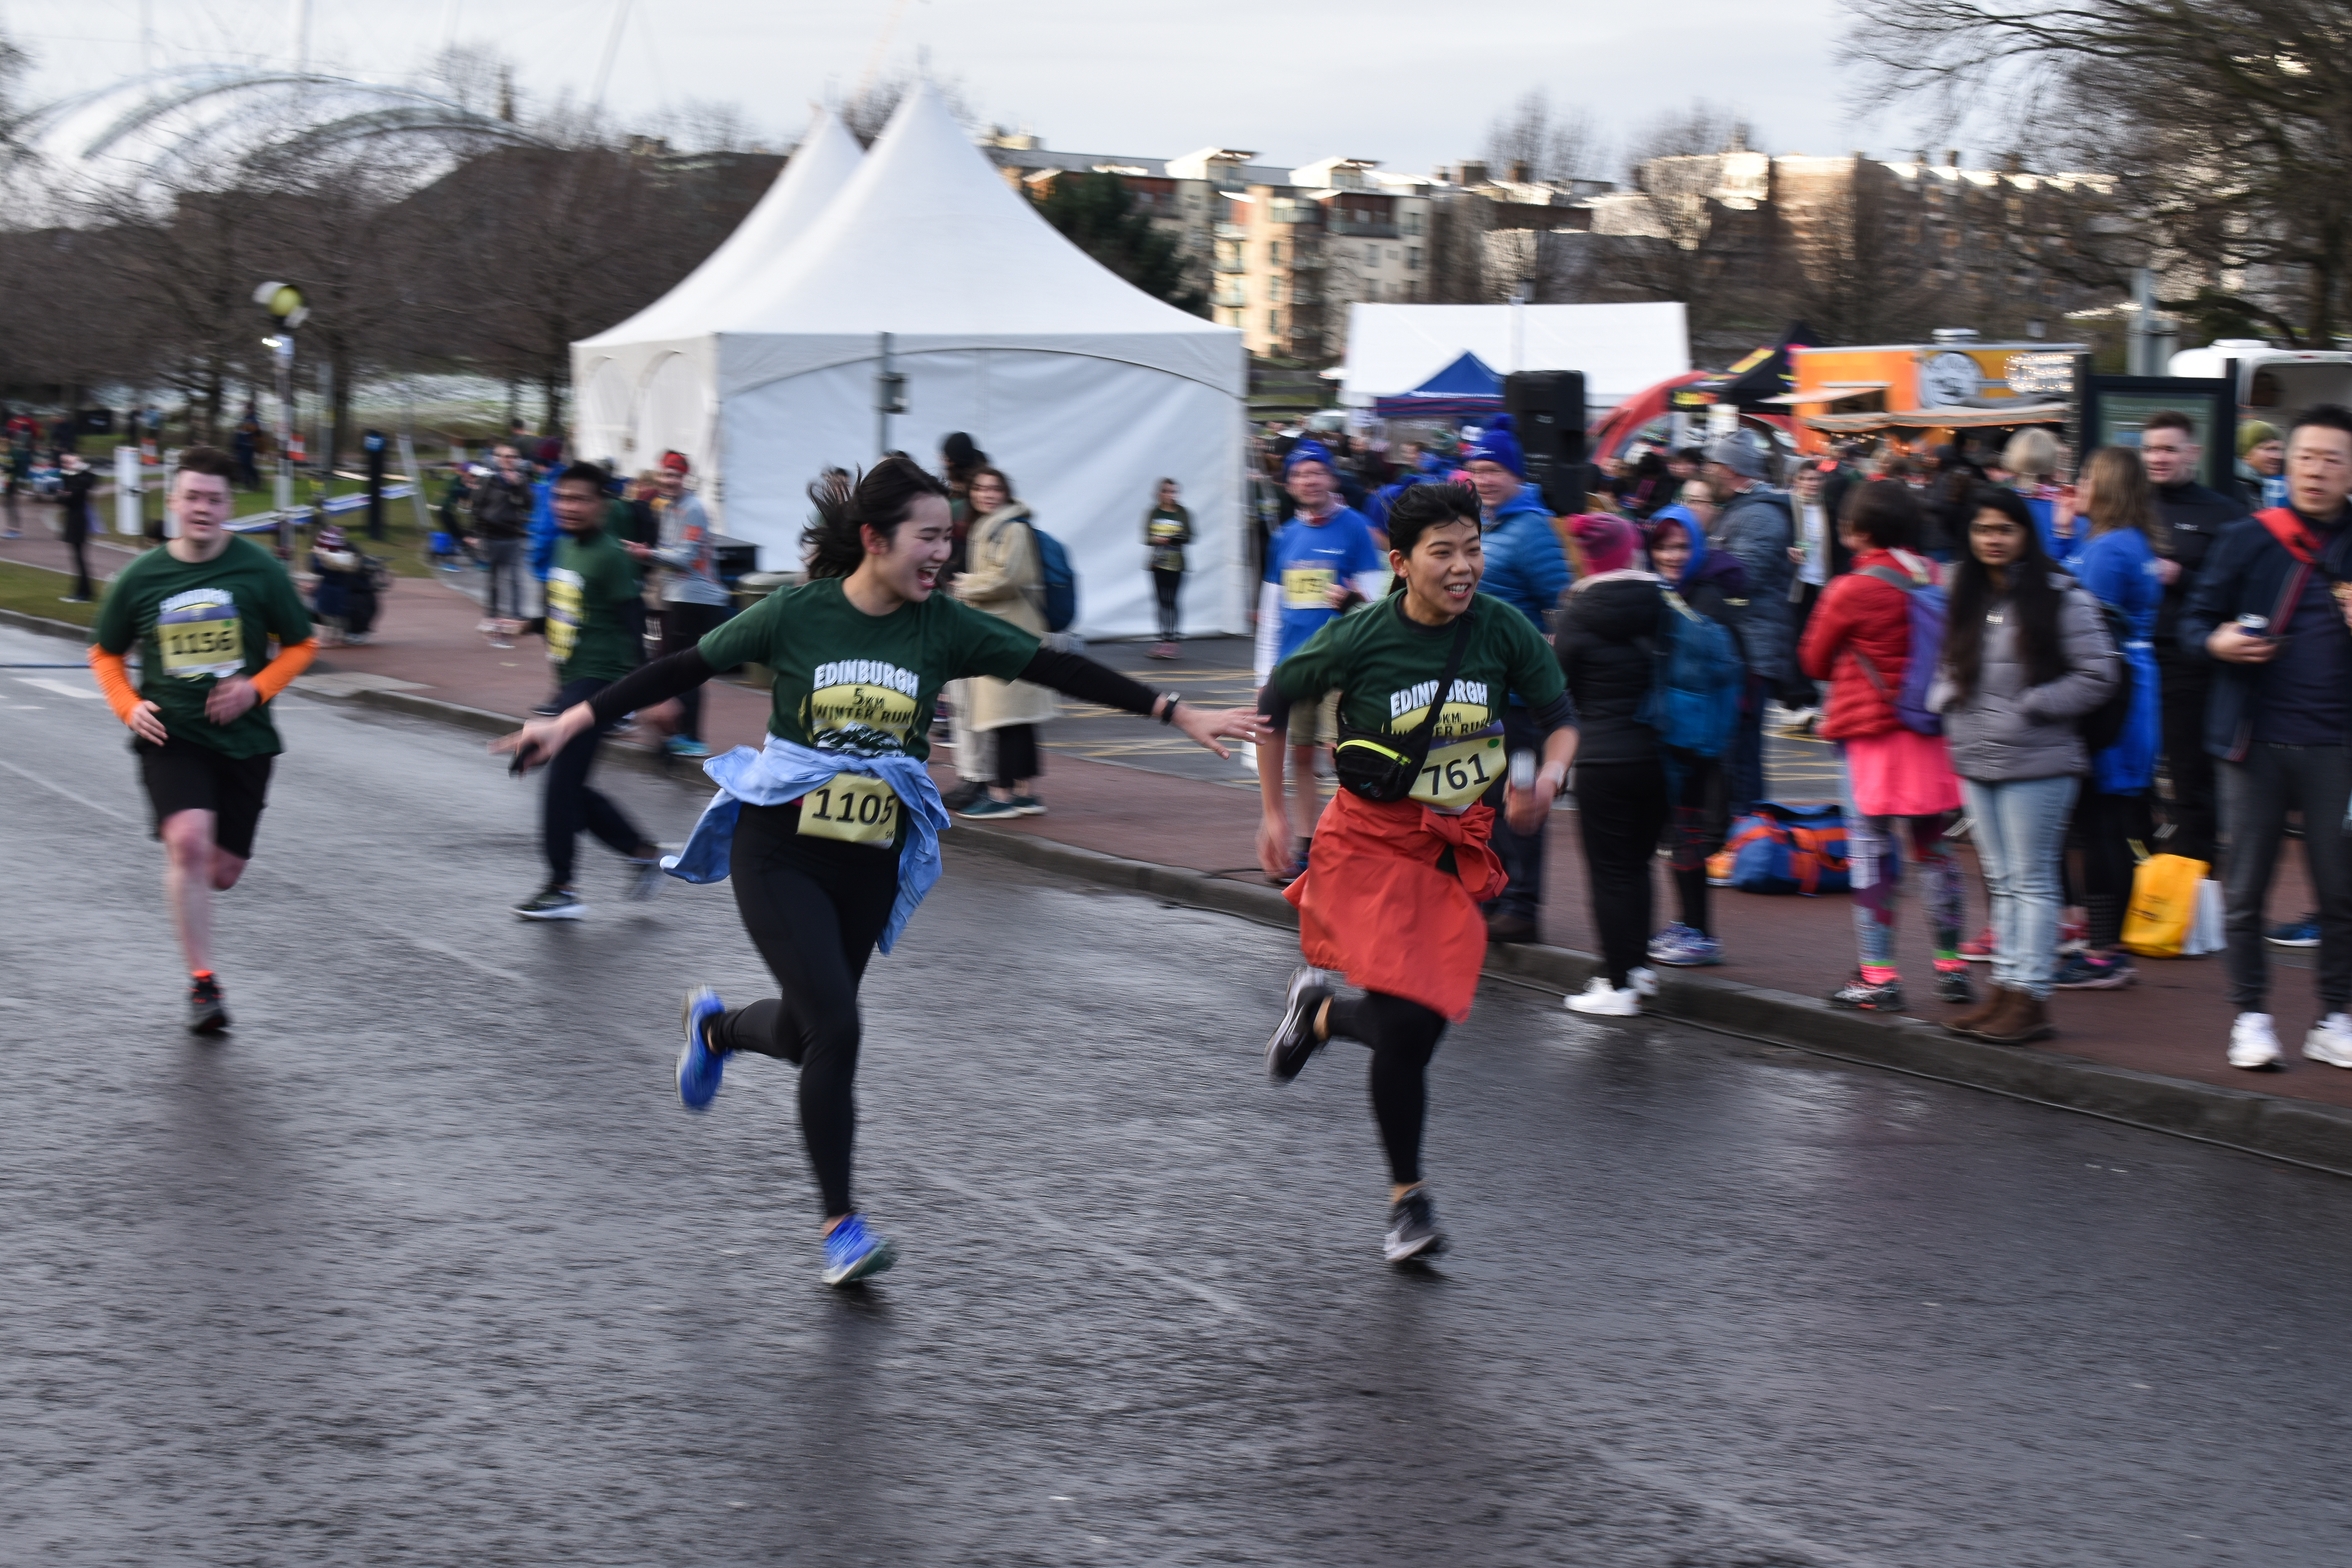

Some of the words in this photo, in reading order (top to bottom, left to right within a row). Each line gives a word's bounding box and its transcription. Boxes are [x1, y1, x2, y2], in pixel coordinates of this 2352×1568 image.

[813, 659, 920, 699] EDINBURGH
[814, 703, 875, 721] WINTER
[880, 710, 913, 723] RUN
[853, 686, 886, 711] 5KM
[1439, 711, 1462, 725] KM
[1421, 753, 1490, 796] 761
[812, 789, 897, 826] 1105
